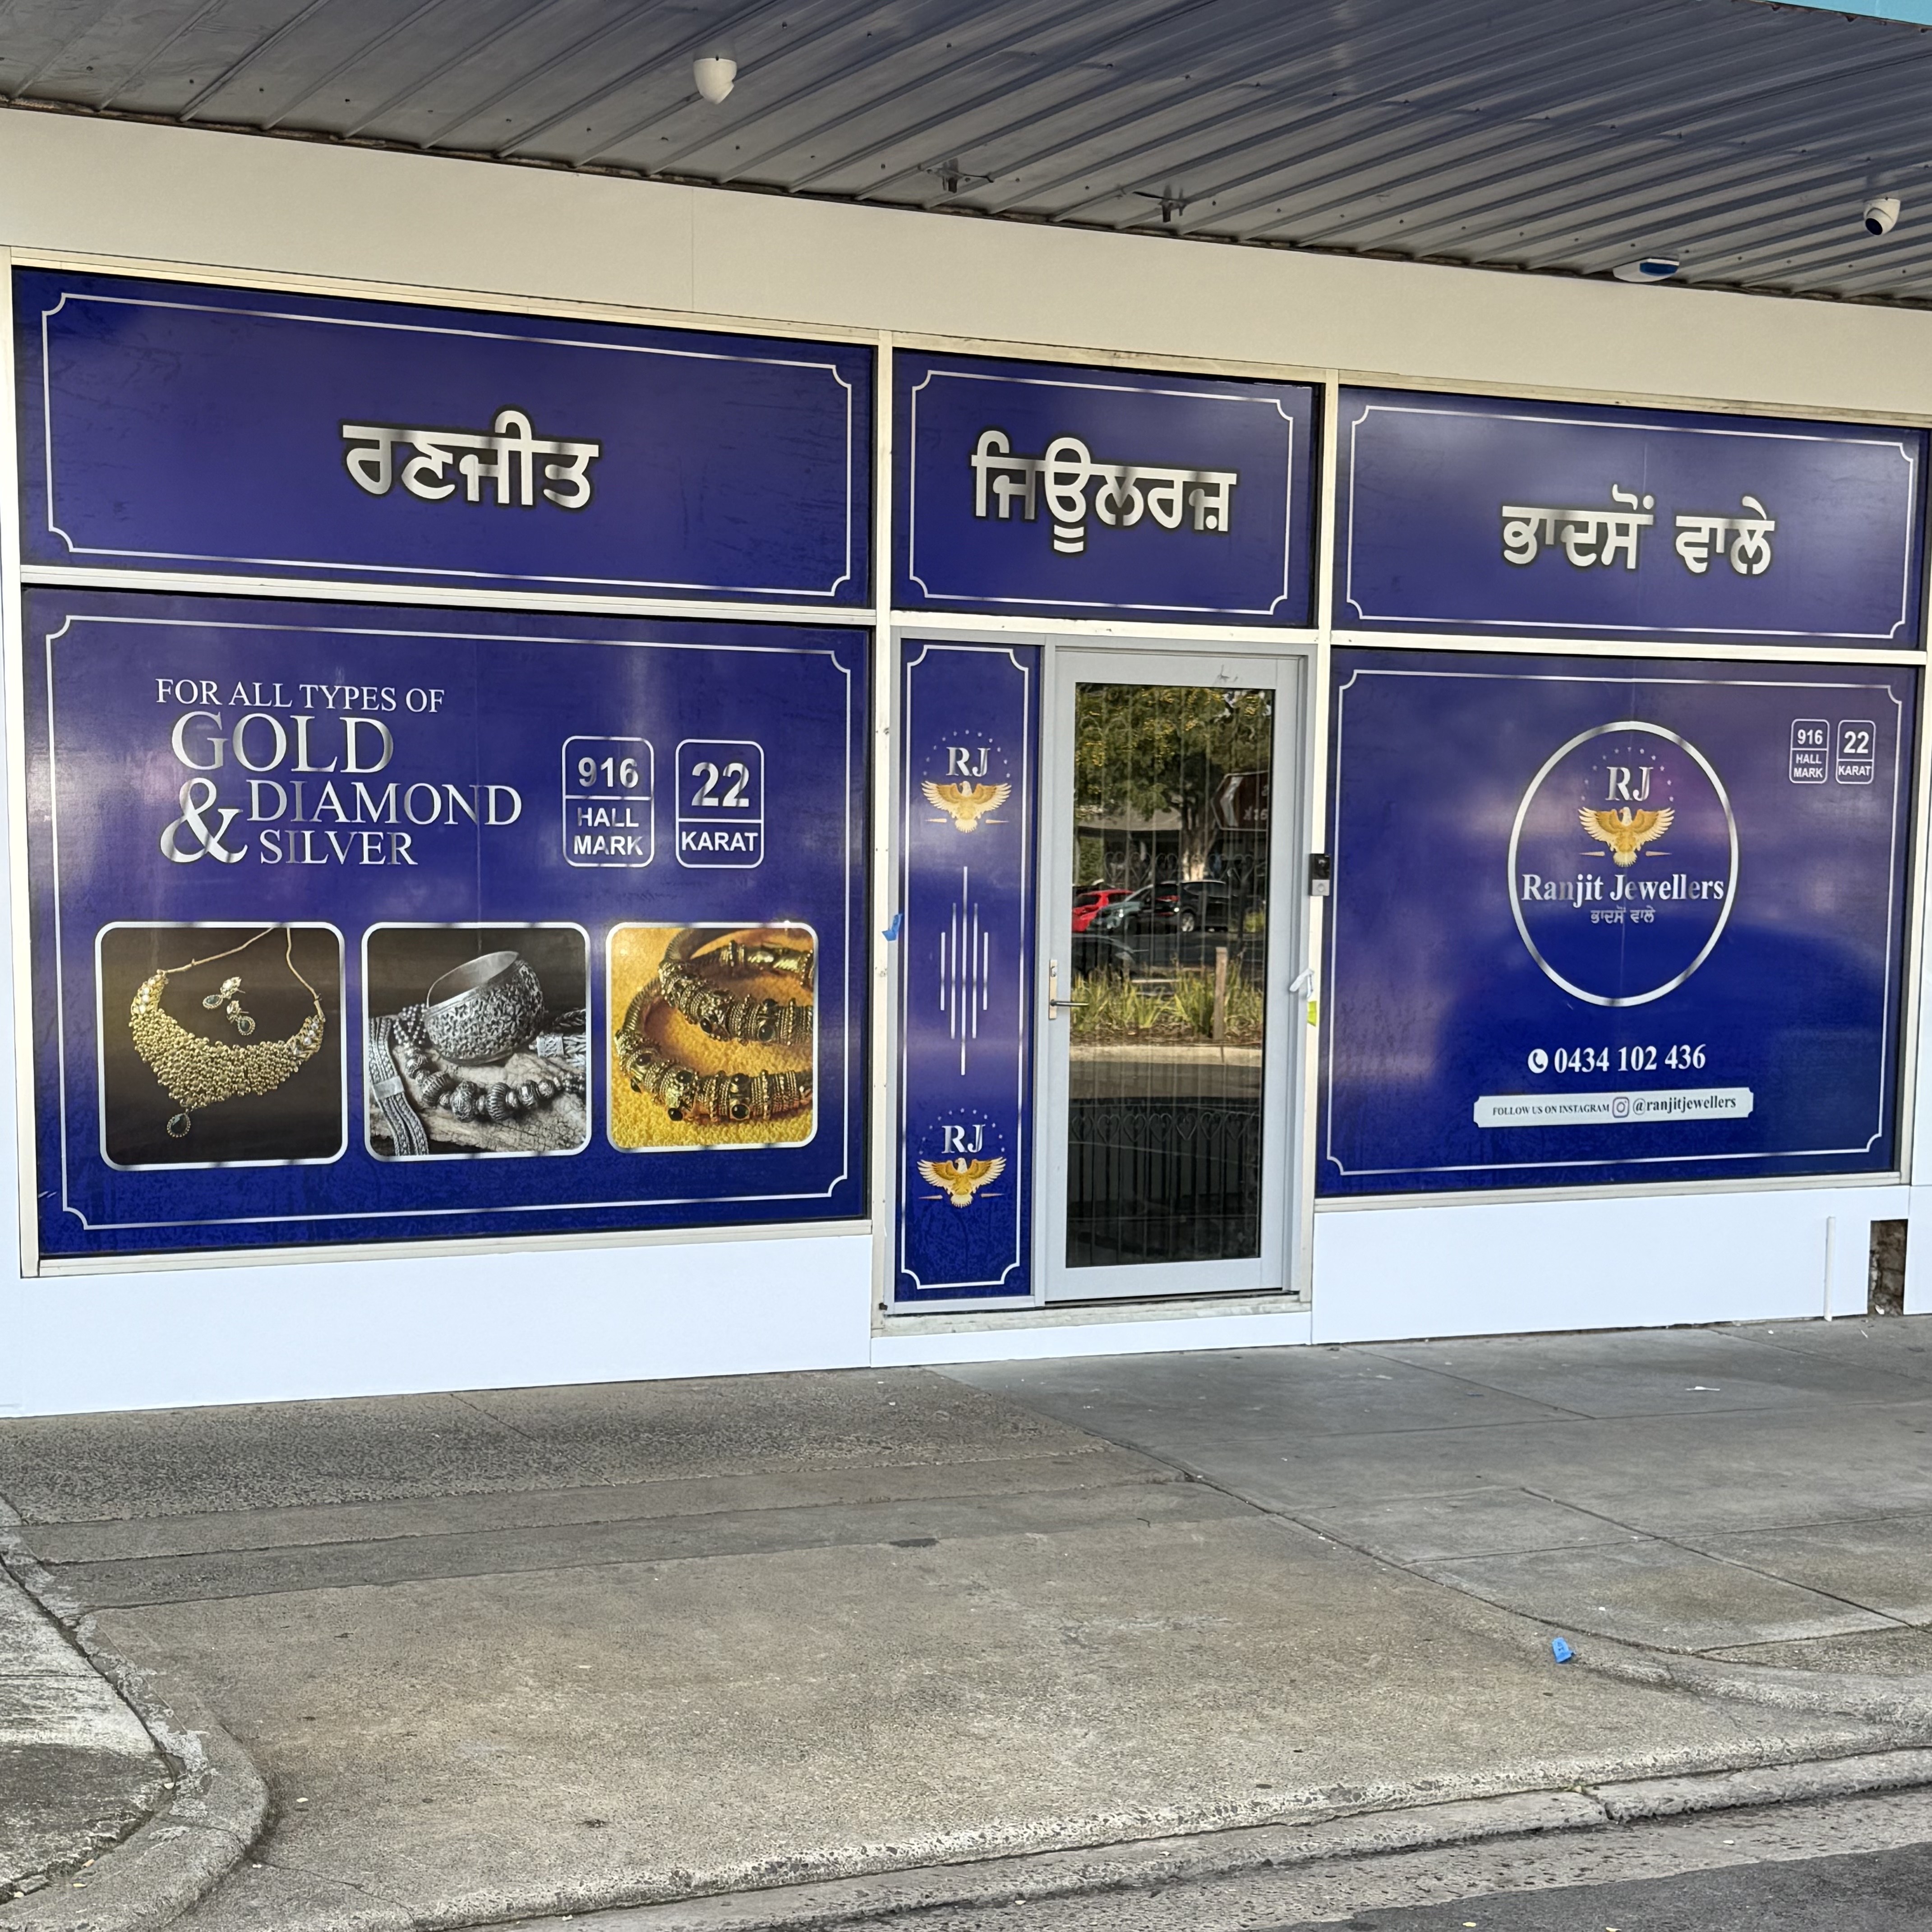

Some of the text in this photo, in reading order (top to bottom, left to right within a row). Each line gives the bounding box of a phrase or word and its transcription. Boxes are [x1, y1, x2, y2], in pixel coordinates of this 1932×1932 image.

[342, 410, 599, 508] ਰਣਜੀਤ
[1502, 484, 1775, 574] ਭਾਦਸੋਂ ਵਾਲੇ
[155, 678, 445, 713] FOR ALL TYPES OF
[171, 711, 394, 774] GOLD
[1797, 729, 1823, 745] 916
[1843, 731, 1869, 754] 22
[578, 757, 639, 788] 916
[945, 747, 991, 777] RJ
[1794, 767, 1823, 778] MARK
[1796, 753, 1822, 764] HALL
[1838, 765, 1872, 776] KARAT
[691, 761, 749, 807] 22
[1605, 766, 1654, 802] RJ
[246, 779, 522, 825] DIAMOND
[577, 807, 639, 827] HALL
[160, 777, 249, 863] &
[260, 829, 418, 865] SILVER
[574, 835, 644, 856] MARK
[681, 831, 758, 852] KARAT
[1521, 873, 1724, 908] Ranjit Jewellers
[1629, 905, 1656, 923] ਵਾਲੇ
[1554, 1044, 1706, 1073] 0434 102 436
[1492, 1095, 1736, 1116] FOLLOW US ON INSTAGRAM @ranjitjewellers
[941, 1124, 986, 1154] RJ
